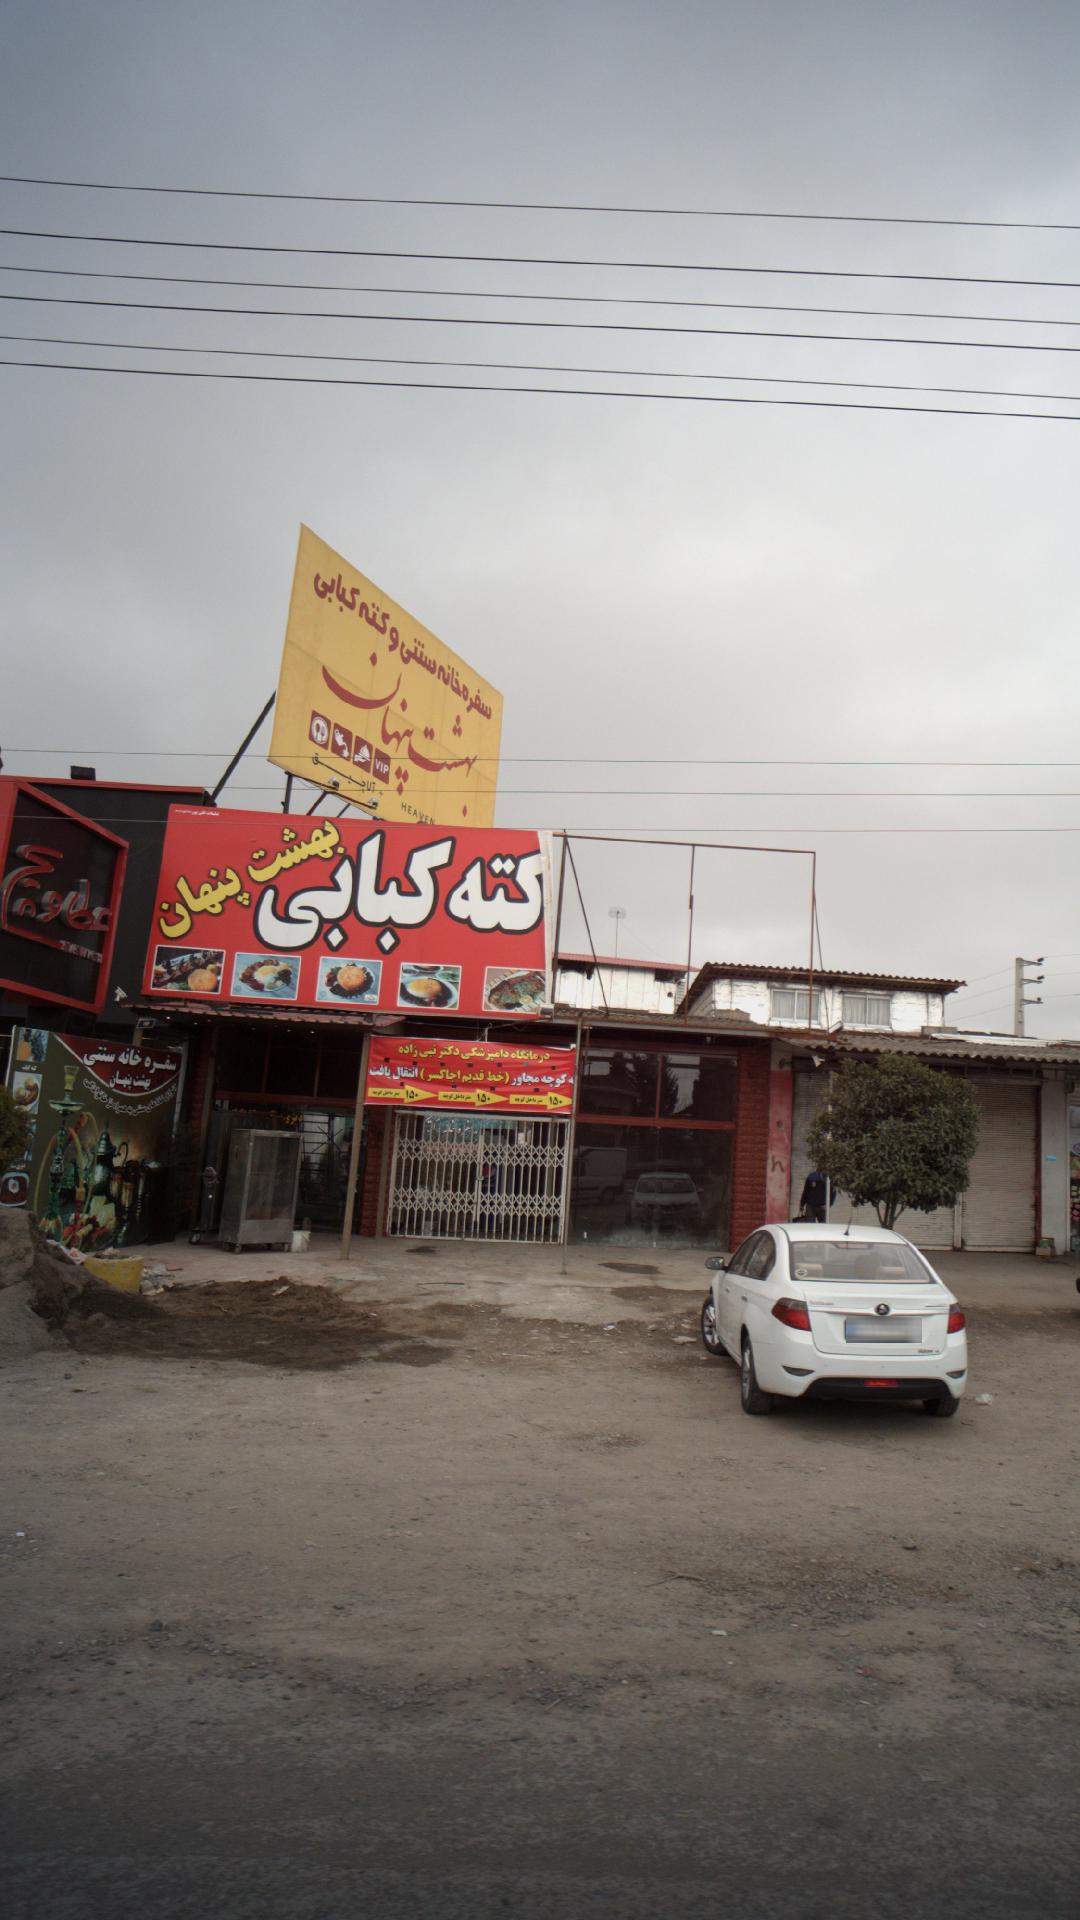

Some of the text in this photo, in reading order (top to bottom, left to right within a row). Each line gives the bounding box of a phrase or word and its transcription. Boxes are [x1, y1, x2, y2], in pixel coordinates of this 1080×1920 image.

[313, 572, 361, 612] کبابی
[358, 601, 391, 635] کته
[388, 626, 400, 652] و
[400, 637, 437, 675] سنتی
[375, 759, 390, 775] VIP
[156, 818, 345, 939] بهشت پنهان
[252, 829, 544, 956] کته کبابی
[83, 1045, 177, 1074] سفره خانه سنتی
[398, 1043, 551, 1063] درمانگاه دامپزشکی دکتر نبی زاده
[368, 1064, 392, 1079] یافت
[393, 1066, 419, 1080] انتقال
[461, 1070, 486, 1083] قدیم
[511, 1072, 540, 1086] مجاور
[541, 1073, 568, 1087] کوچه
[405, 1090, 419, 1100] ۱۵۰
[476, 1093, 491, 1103] ۱۵۰
[548, 1096, 563, 1105] ۱۵۰
